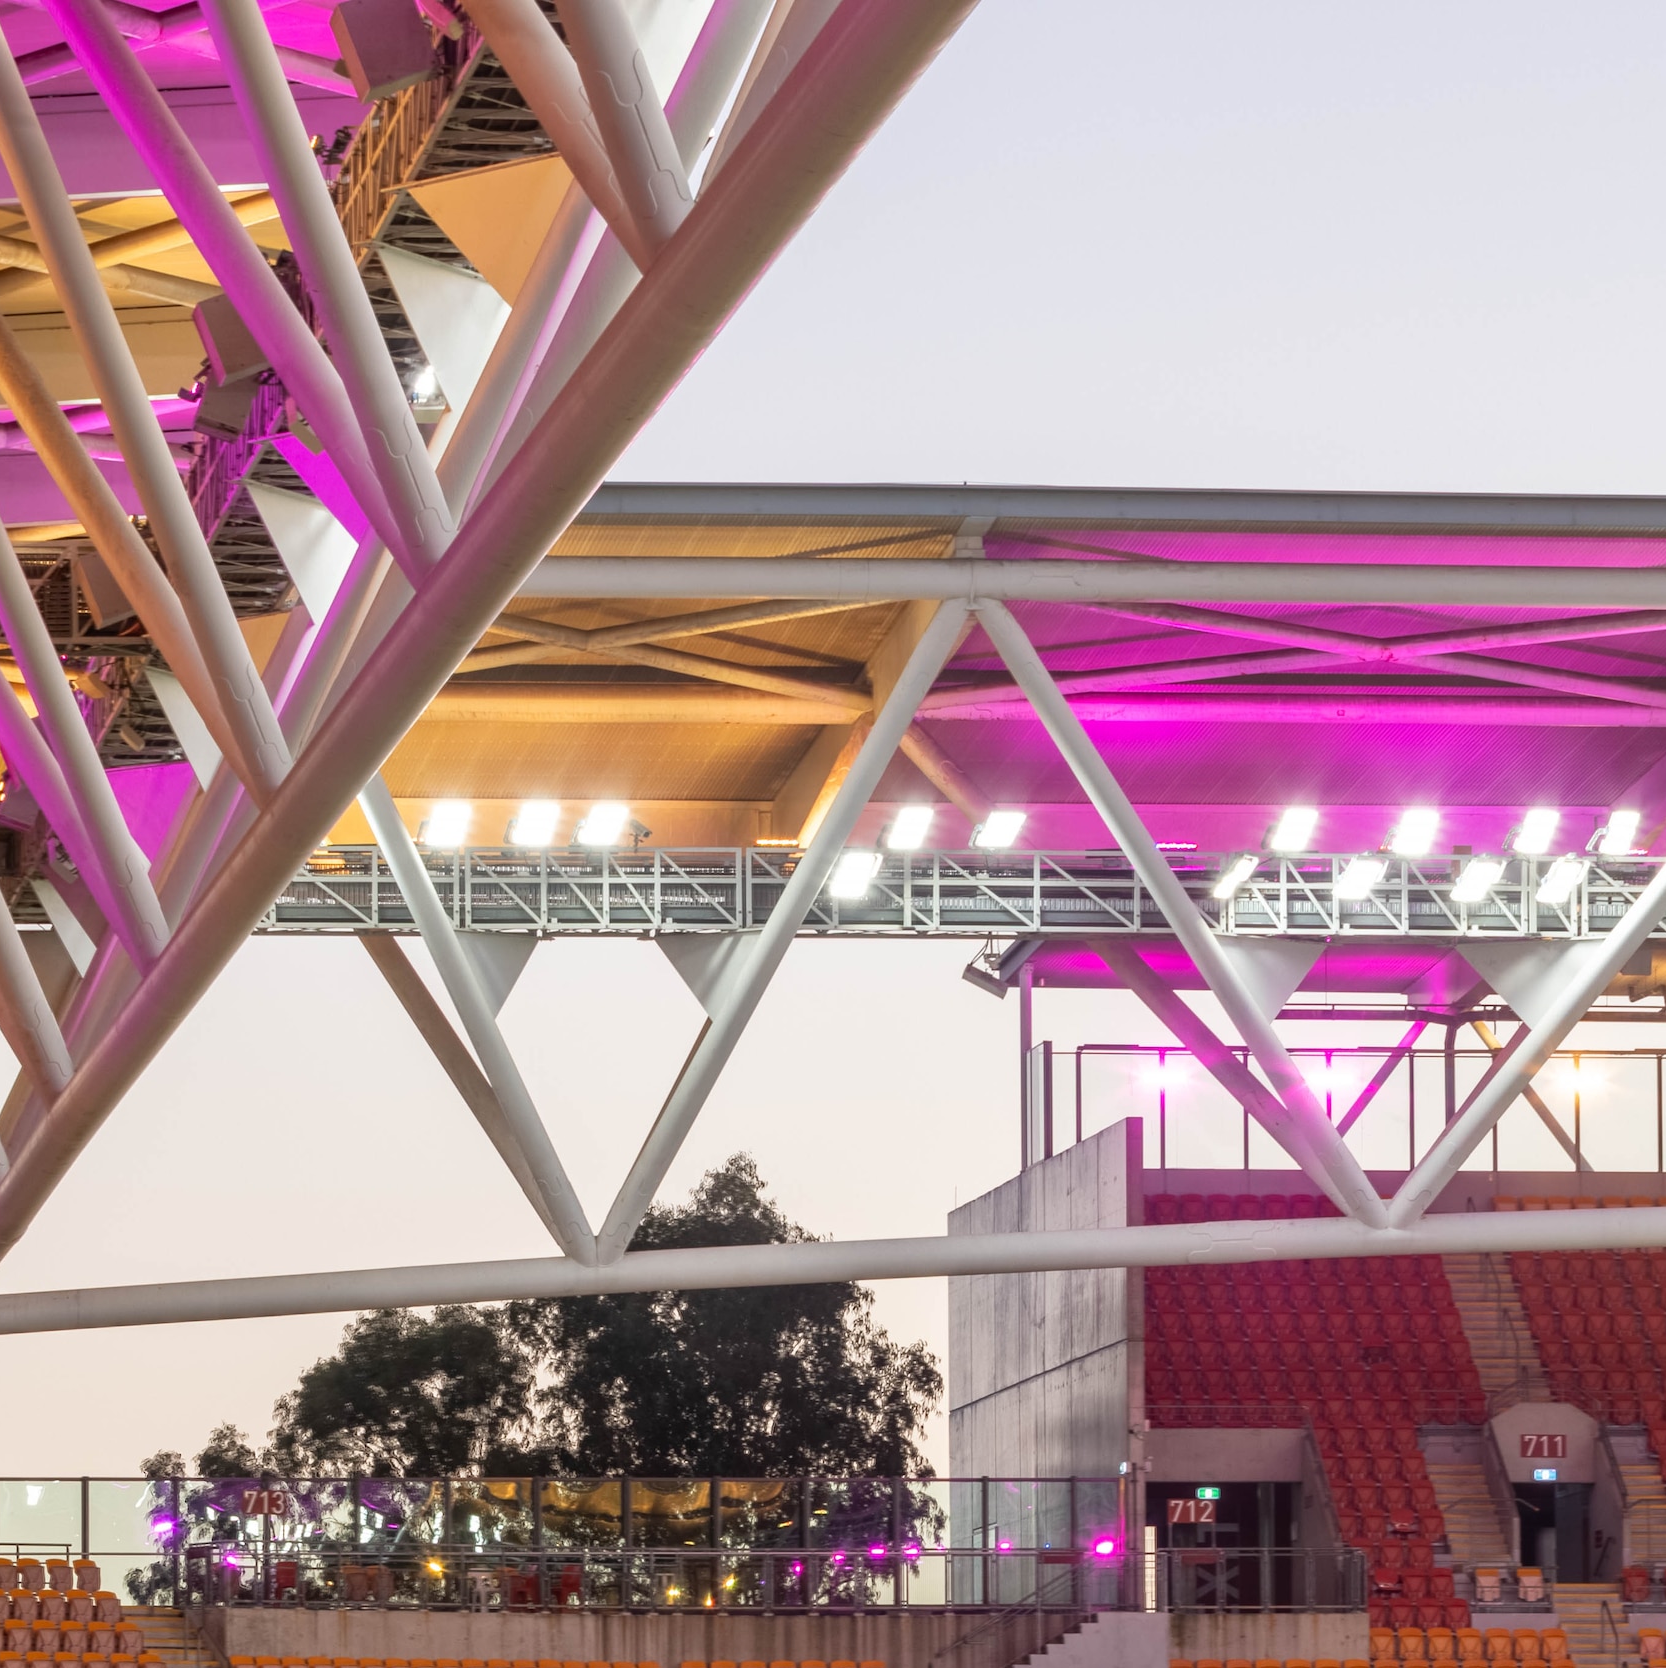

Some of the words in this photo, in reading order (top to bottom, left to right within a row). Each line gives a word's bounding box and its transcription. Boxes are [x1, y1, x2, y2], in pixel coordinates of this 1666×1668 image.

[1523, 1436, 1565, 1457] 711
[244, 1491, 285, 1514] 713
[1169, 1501, 1213, 1522] 712
